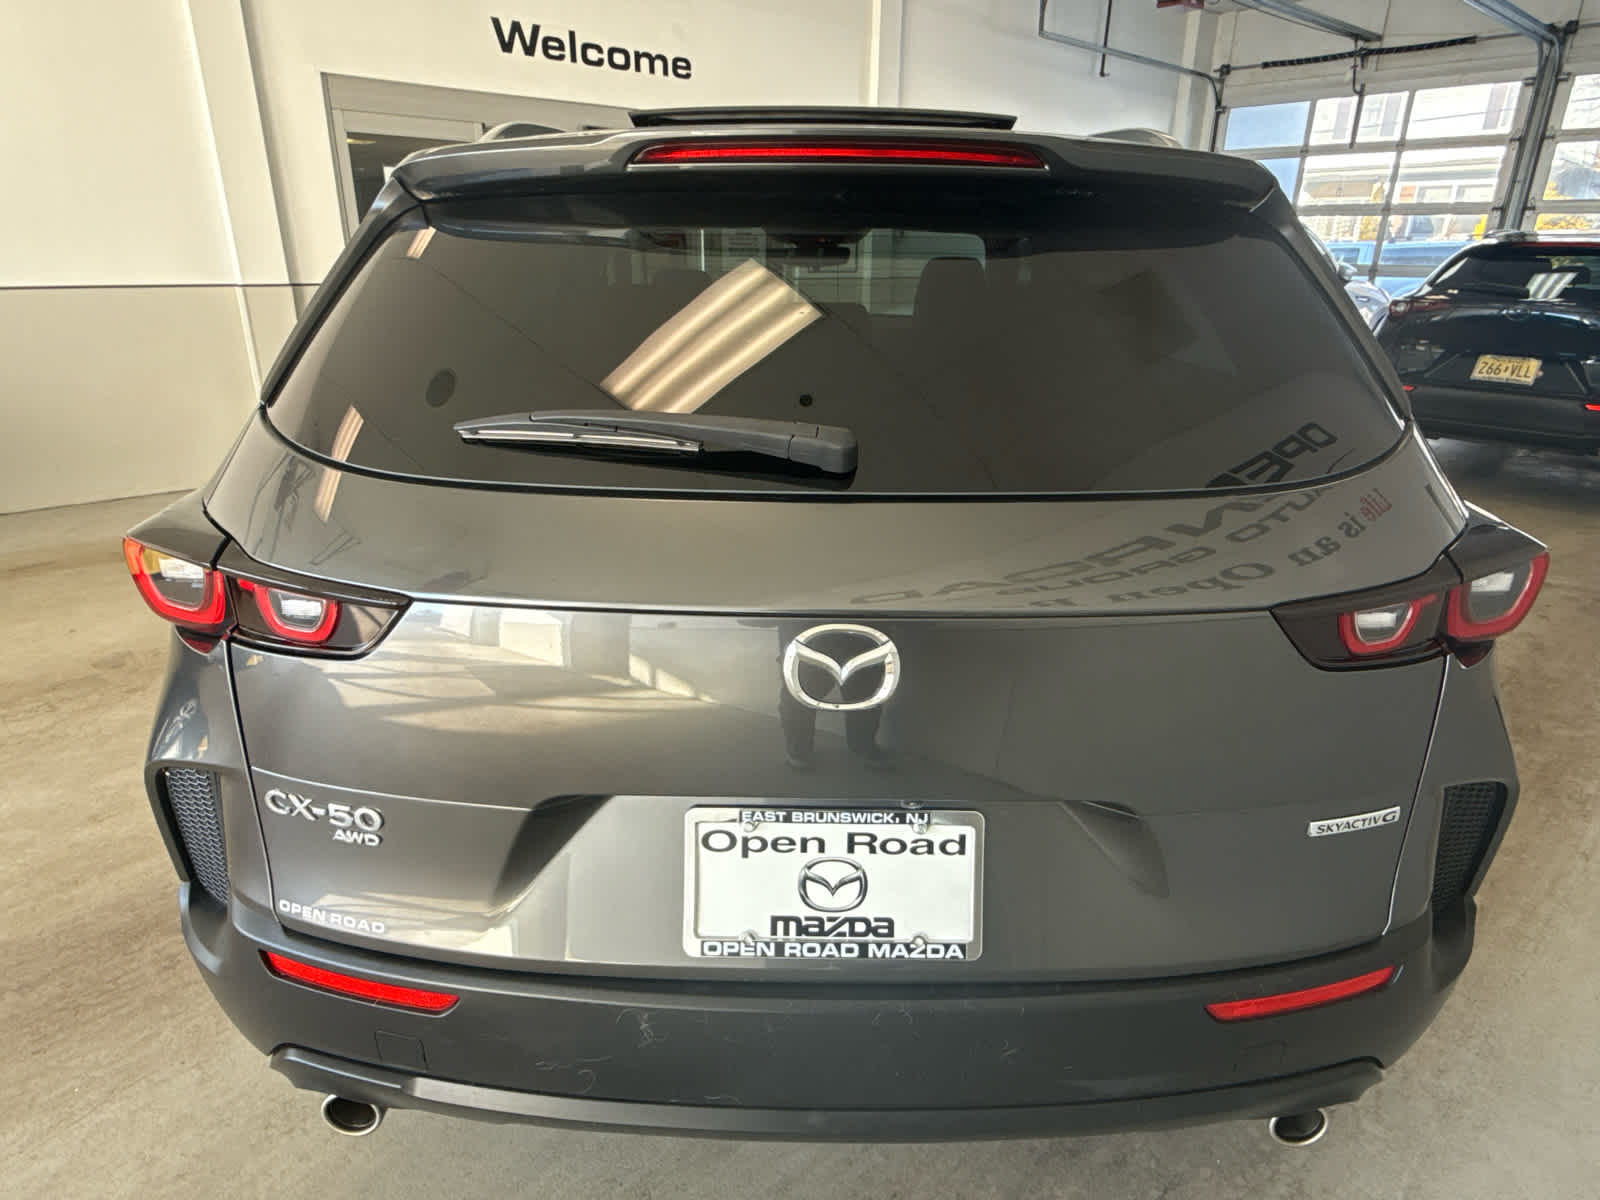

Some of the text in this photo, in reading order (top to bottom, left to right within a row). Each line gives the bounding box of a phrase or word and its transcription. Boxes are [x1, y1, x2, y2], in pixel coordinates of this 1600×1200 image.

[490, 16, 692, 80] Welcome
[264, 788, 384, 832] CX-50
[742, 811, 786, 824] EAST
[906, 813, 928, 825] NJ
[333, 829, 383, 847] AWD
[701, 829, 967, 859] Open Road
[279, 899, 385, 934] OPEN ROAD
[703, 941, 965, 959] OPEN ROAD MAZDA
